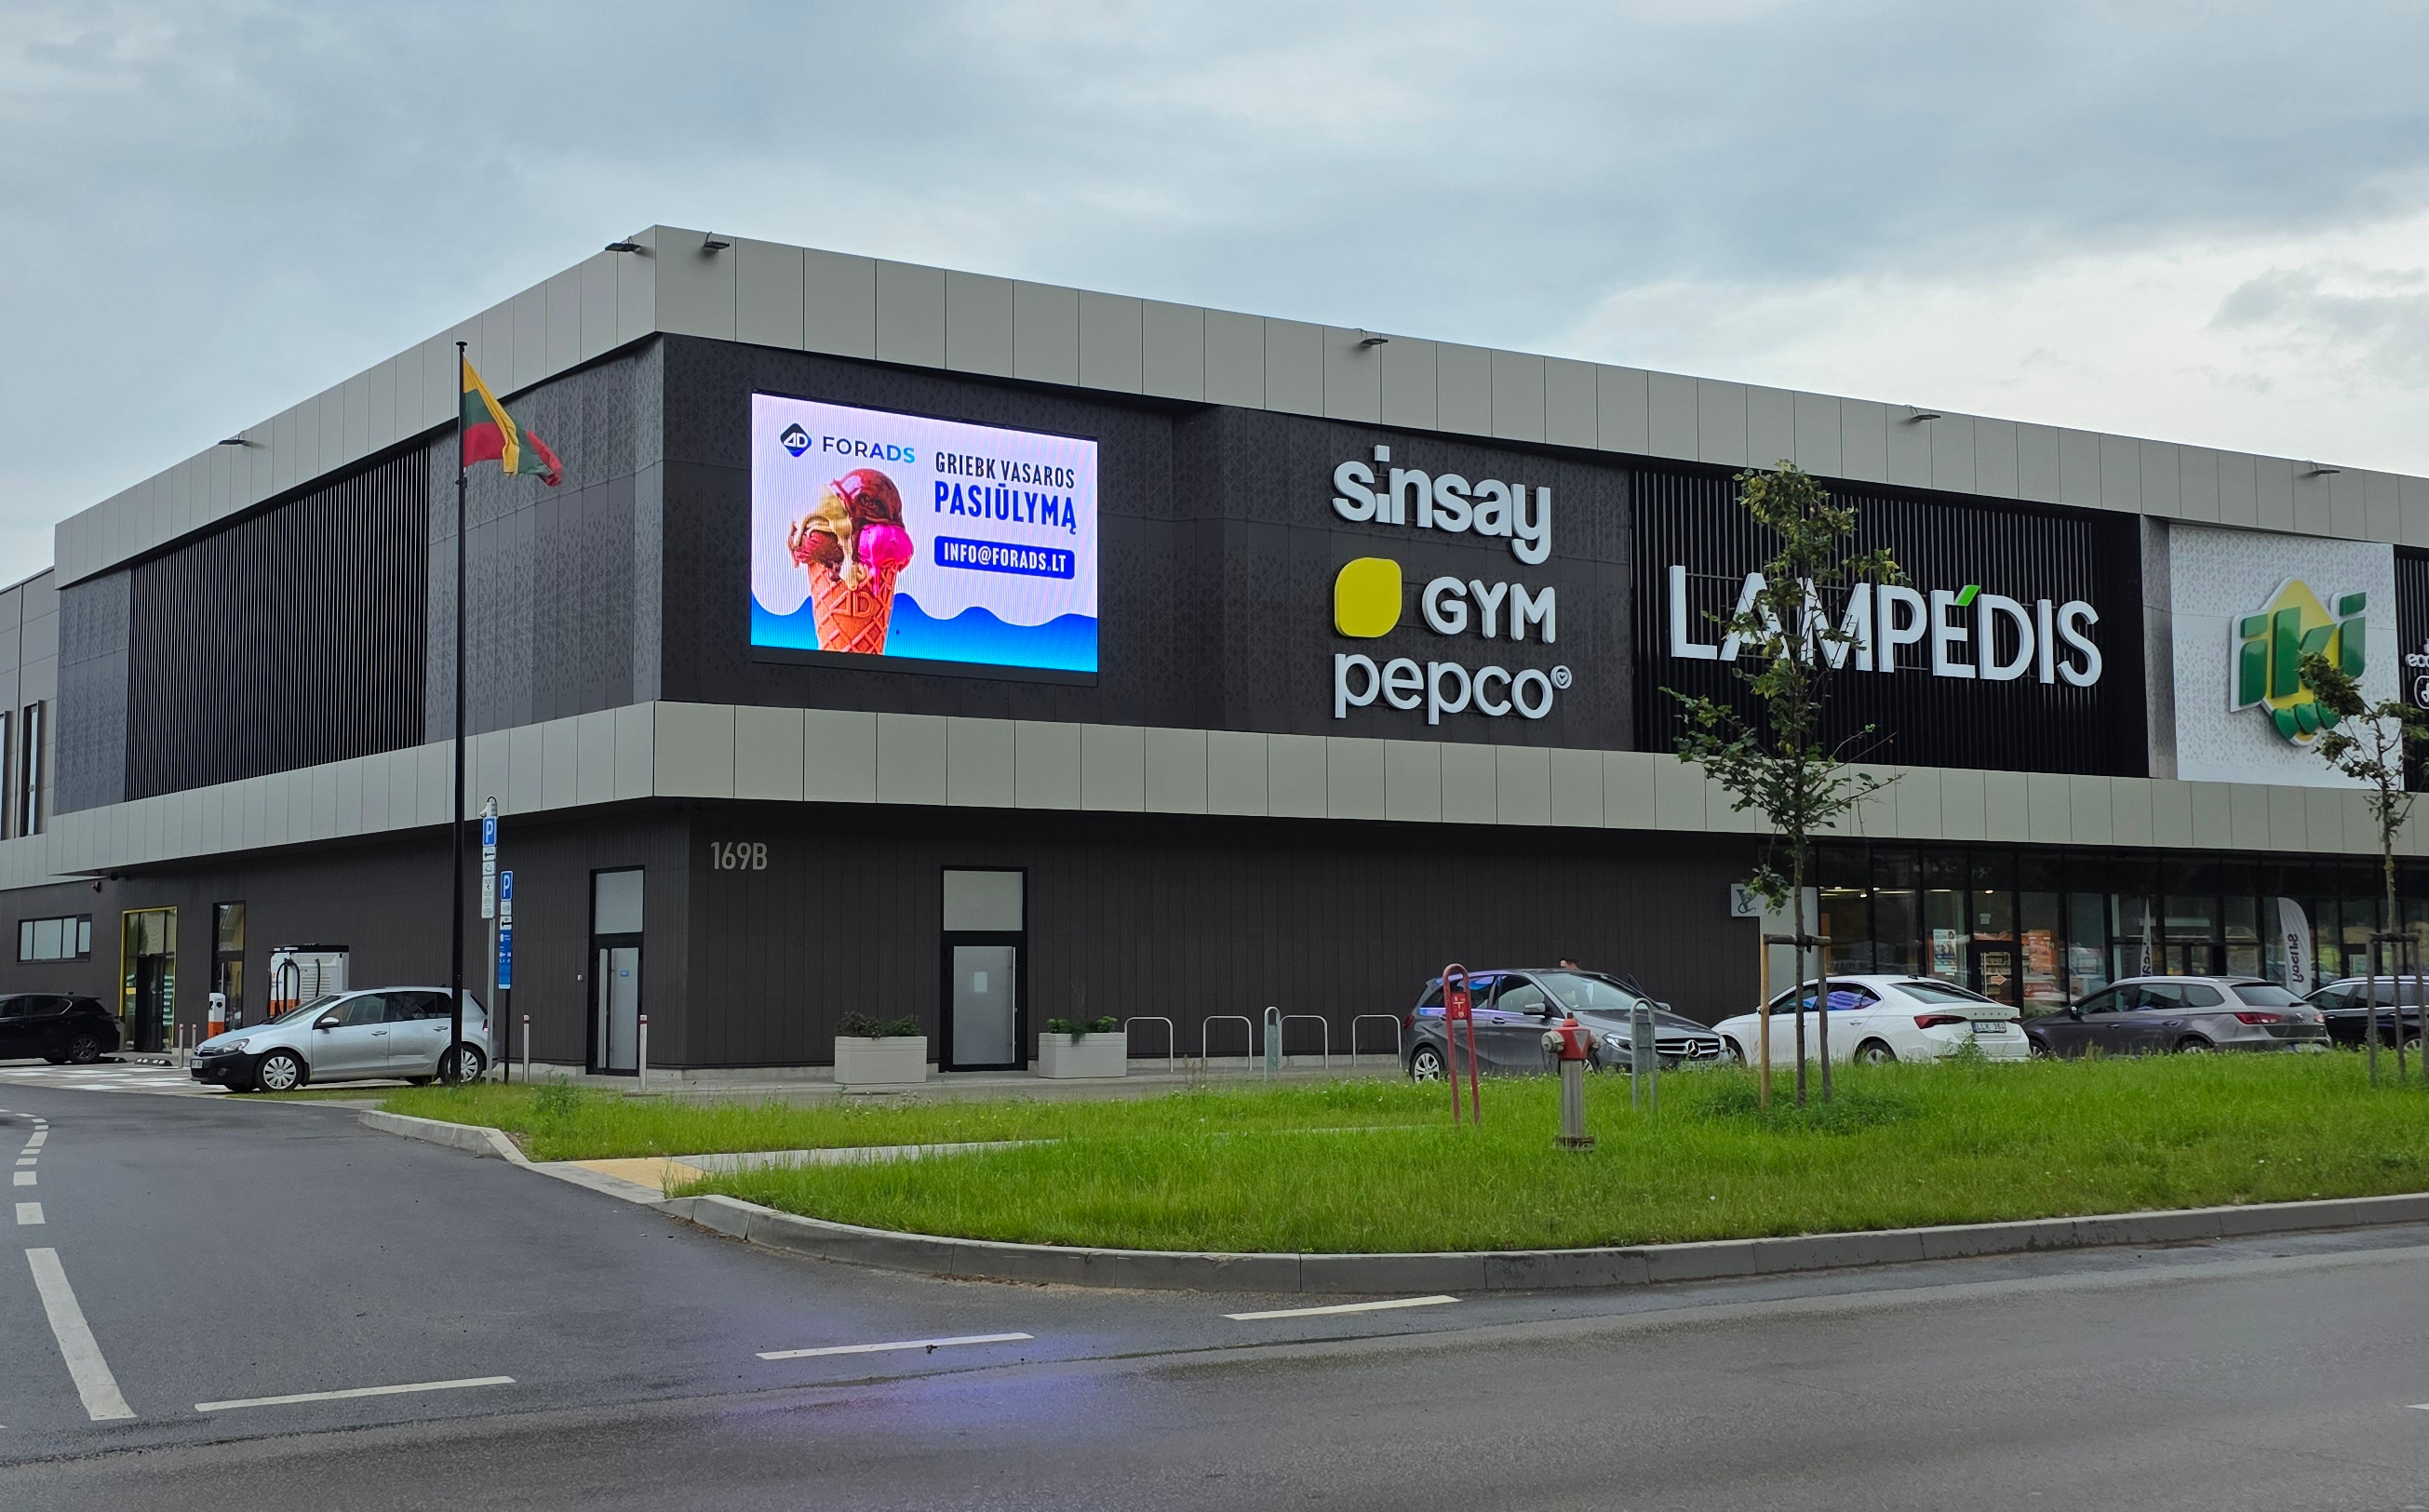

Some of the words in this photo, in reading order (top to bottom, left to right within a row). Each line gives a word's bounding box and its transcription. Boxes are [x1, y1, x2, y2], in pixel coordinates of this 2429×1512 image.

[823, 435, 916, 464] FORADS
[935, 451, 996, 480] GRIEBK
[1000, 460, 1075, 489] VASAROS
[934, 480, 1077, 535] PASIŪLYMĄ
[1333, 445, 1551, 565] sinsay
[944, 542, 1067, 573] INFO@FORADS.LT
[1422, 576, 1555, 644] GYM
[1335, 653, 1554, 725] pepco
[485, 820, 494, 843] P
[711, 841, 768, 871] 169B
[503, 874, 511, 898] P
